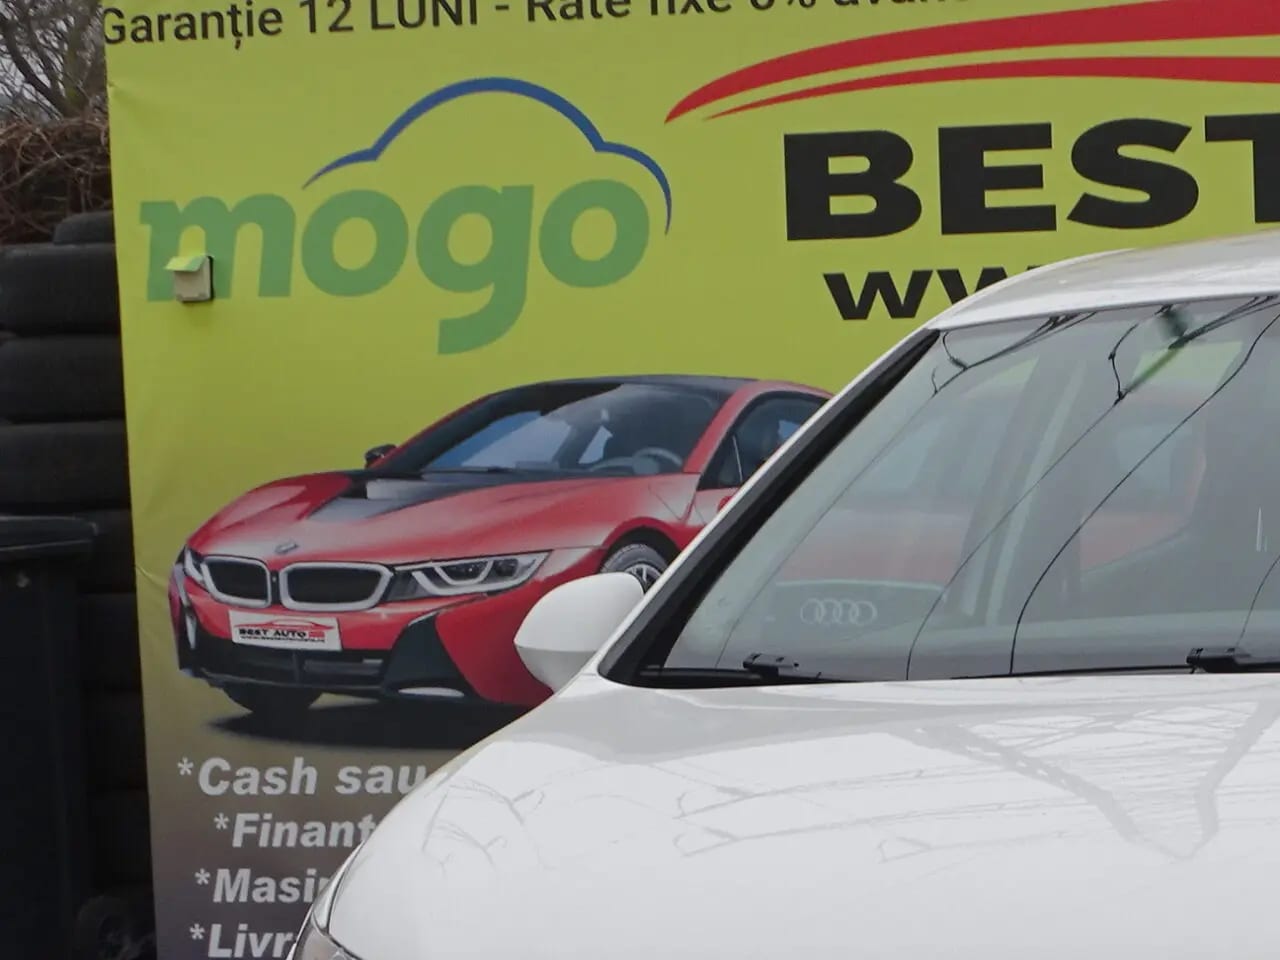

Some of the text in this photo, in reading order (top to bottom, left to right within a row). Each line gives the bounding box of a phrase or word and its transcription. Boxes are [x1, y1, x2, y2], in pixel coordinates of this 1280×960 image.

[300, 0, 354, 34] 12
[371, 0, 479, 31] LUNI
[138, 178, 650, 356] mogo
[335, 764, 428, 795] sau
